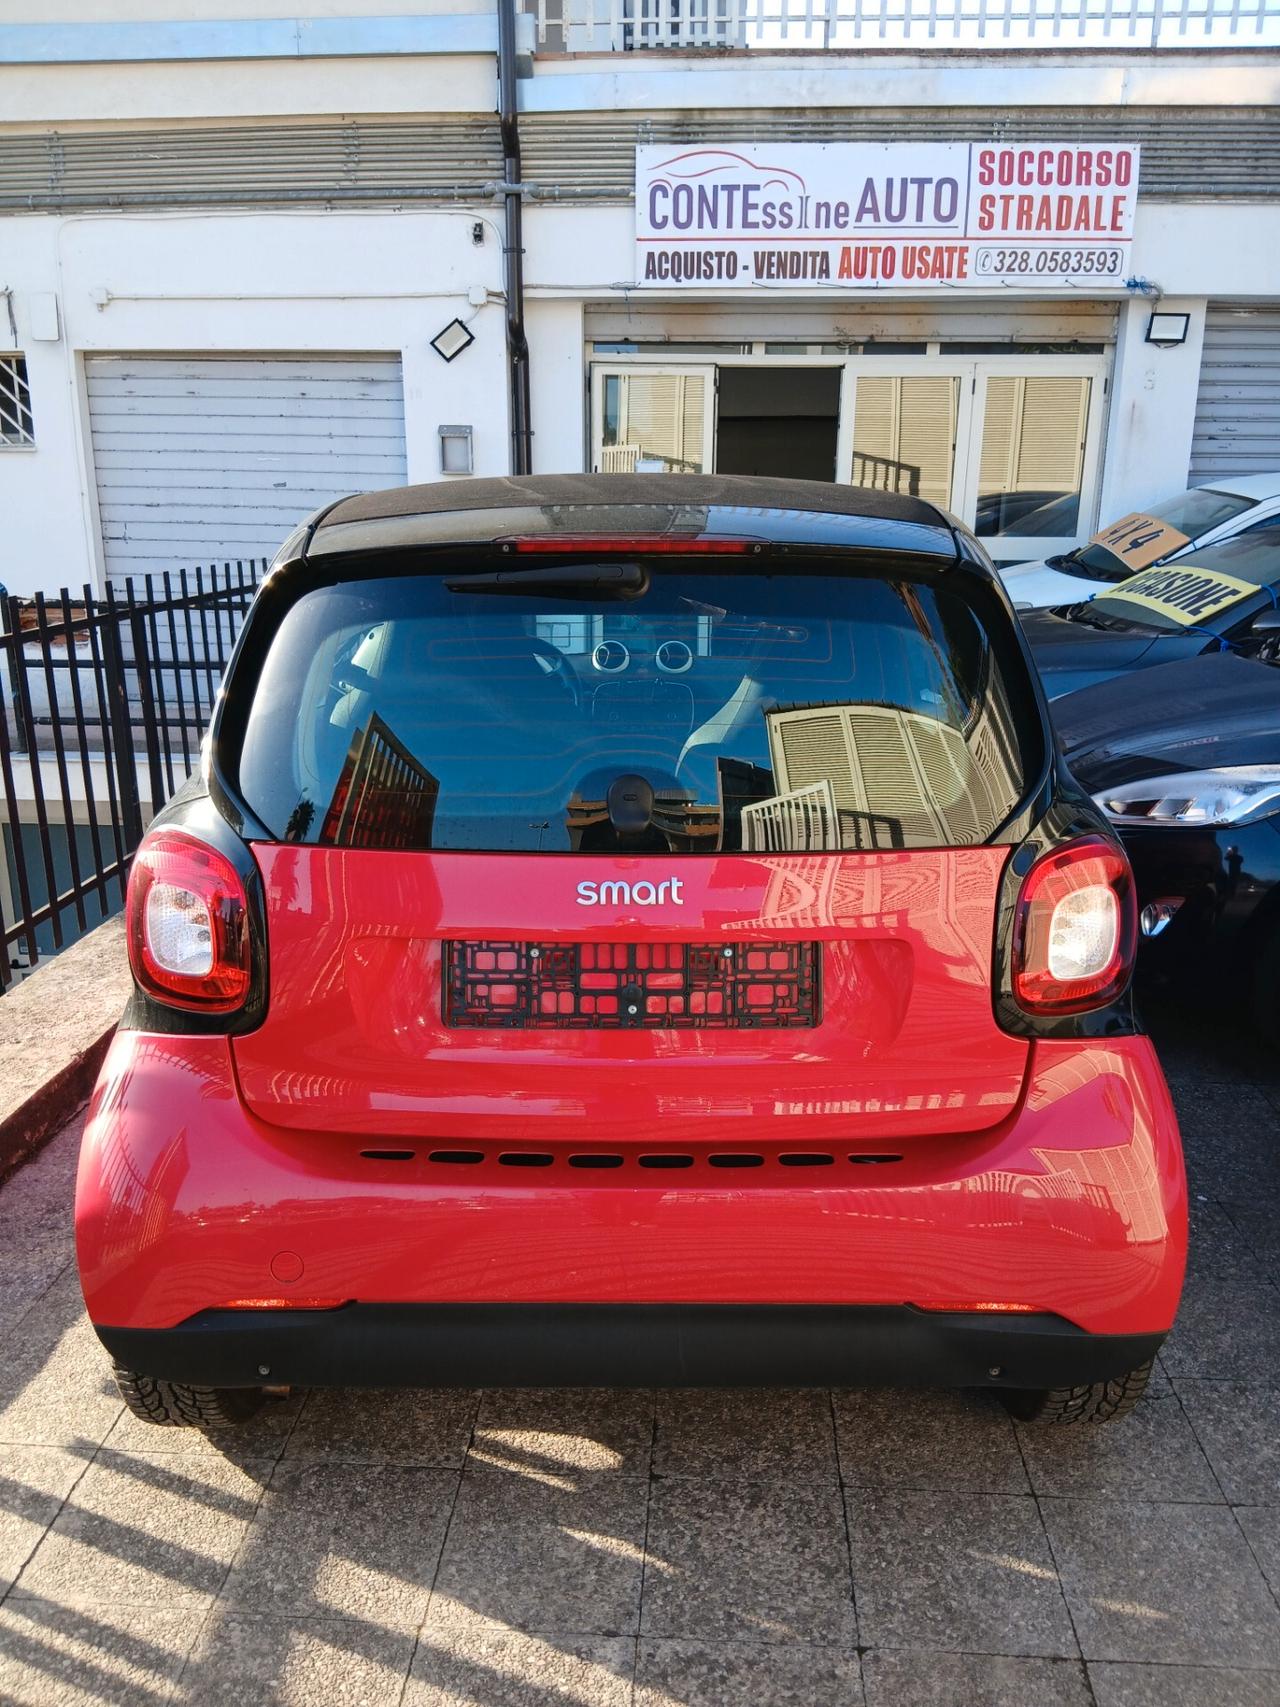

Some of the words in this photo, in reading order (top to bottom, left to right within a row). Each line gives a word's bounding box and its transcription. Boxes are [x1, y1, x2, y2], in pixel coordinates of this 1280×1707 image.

[978, 150, 1132, 187] SOCCORSO
[855, 177, 959, 223] AUTO
[978, 194, 1127, 232] STRADALE
[645, 251, 738, 282] ACQUISTO
[753, 250, 831, 280] VENDITA
[838, 245, 896, 281] AUTO
[902, 246, 969, 280] USATE
[993, 250, 1119, 274] 328.0583593
[576, 876, 684, 906] smart
